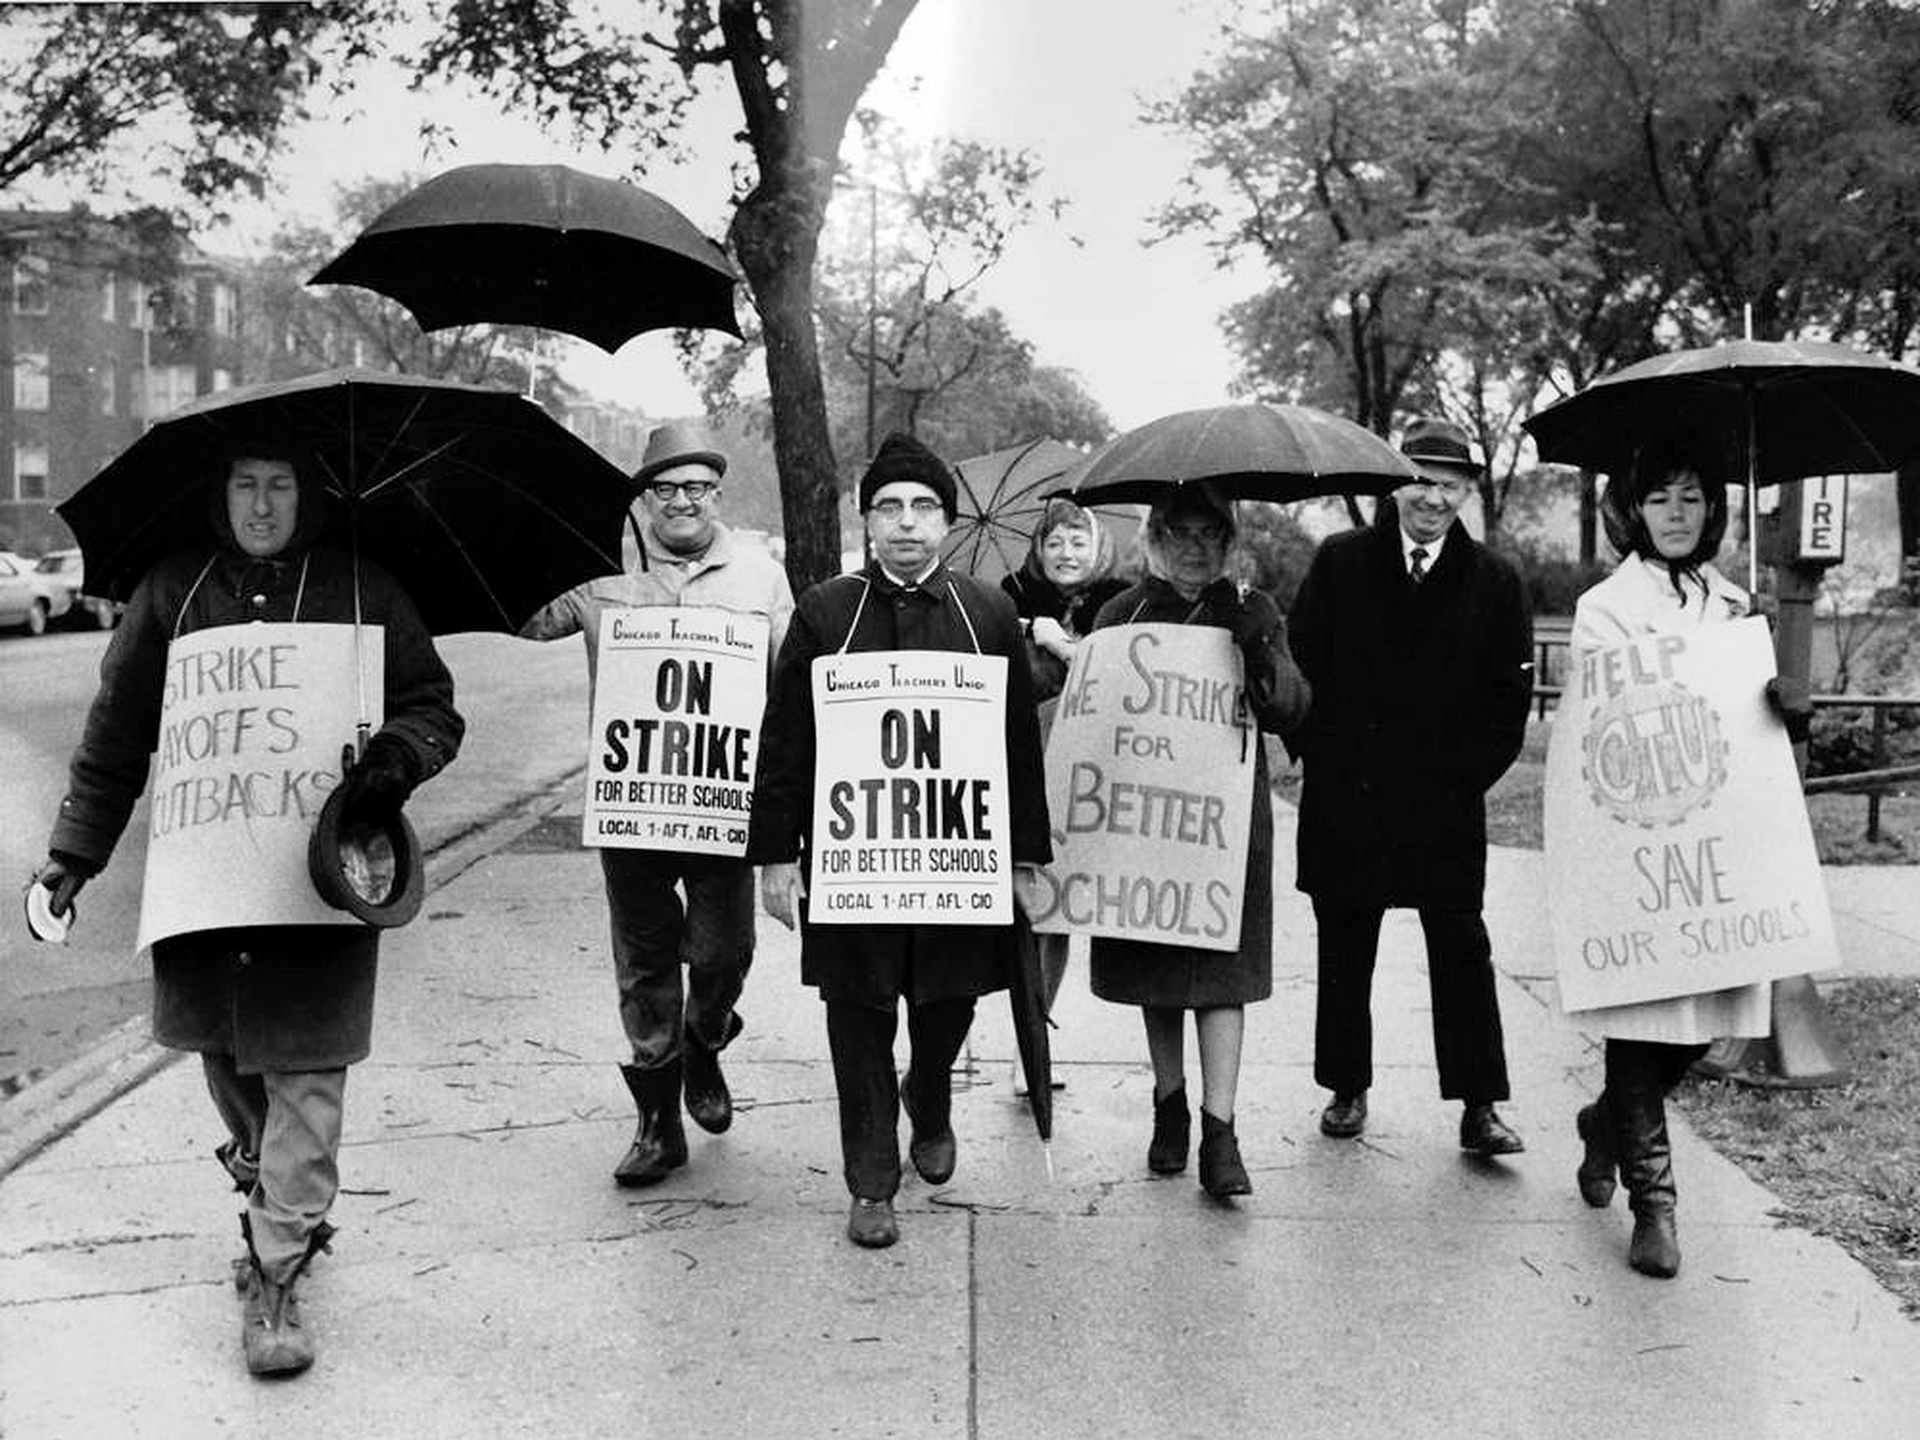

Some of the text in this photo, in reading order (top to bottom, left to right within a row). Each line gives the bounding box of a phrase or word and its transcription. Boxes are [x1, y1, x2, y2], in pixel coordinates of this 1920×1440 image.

[656, 658, 713, 716] ON
[1582, 635, 1687, 700] HELP
[603, 719, 752, 783] STRIKE
[881, 708, 941, 770] ON
[1114, 726, 1175, 761] FOR
[595, 780, 755, 812] FOR BETTER SCHOOLS
[829, 778, 993, 841] STRIKE
[1067, 761, 1228, 850] BETTER
[598, 819, 642, 837] LOCAL
[822, 848, 998, 874] FOR BETTER SCHOOLS
[1633, 836, 1735, 914] SAVE
[828, 893, 874, 910] LOCAL
[1582, 902, 1811, 971] OUR SCHOOLS
